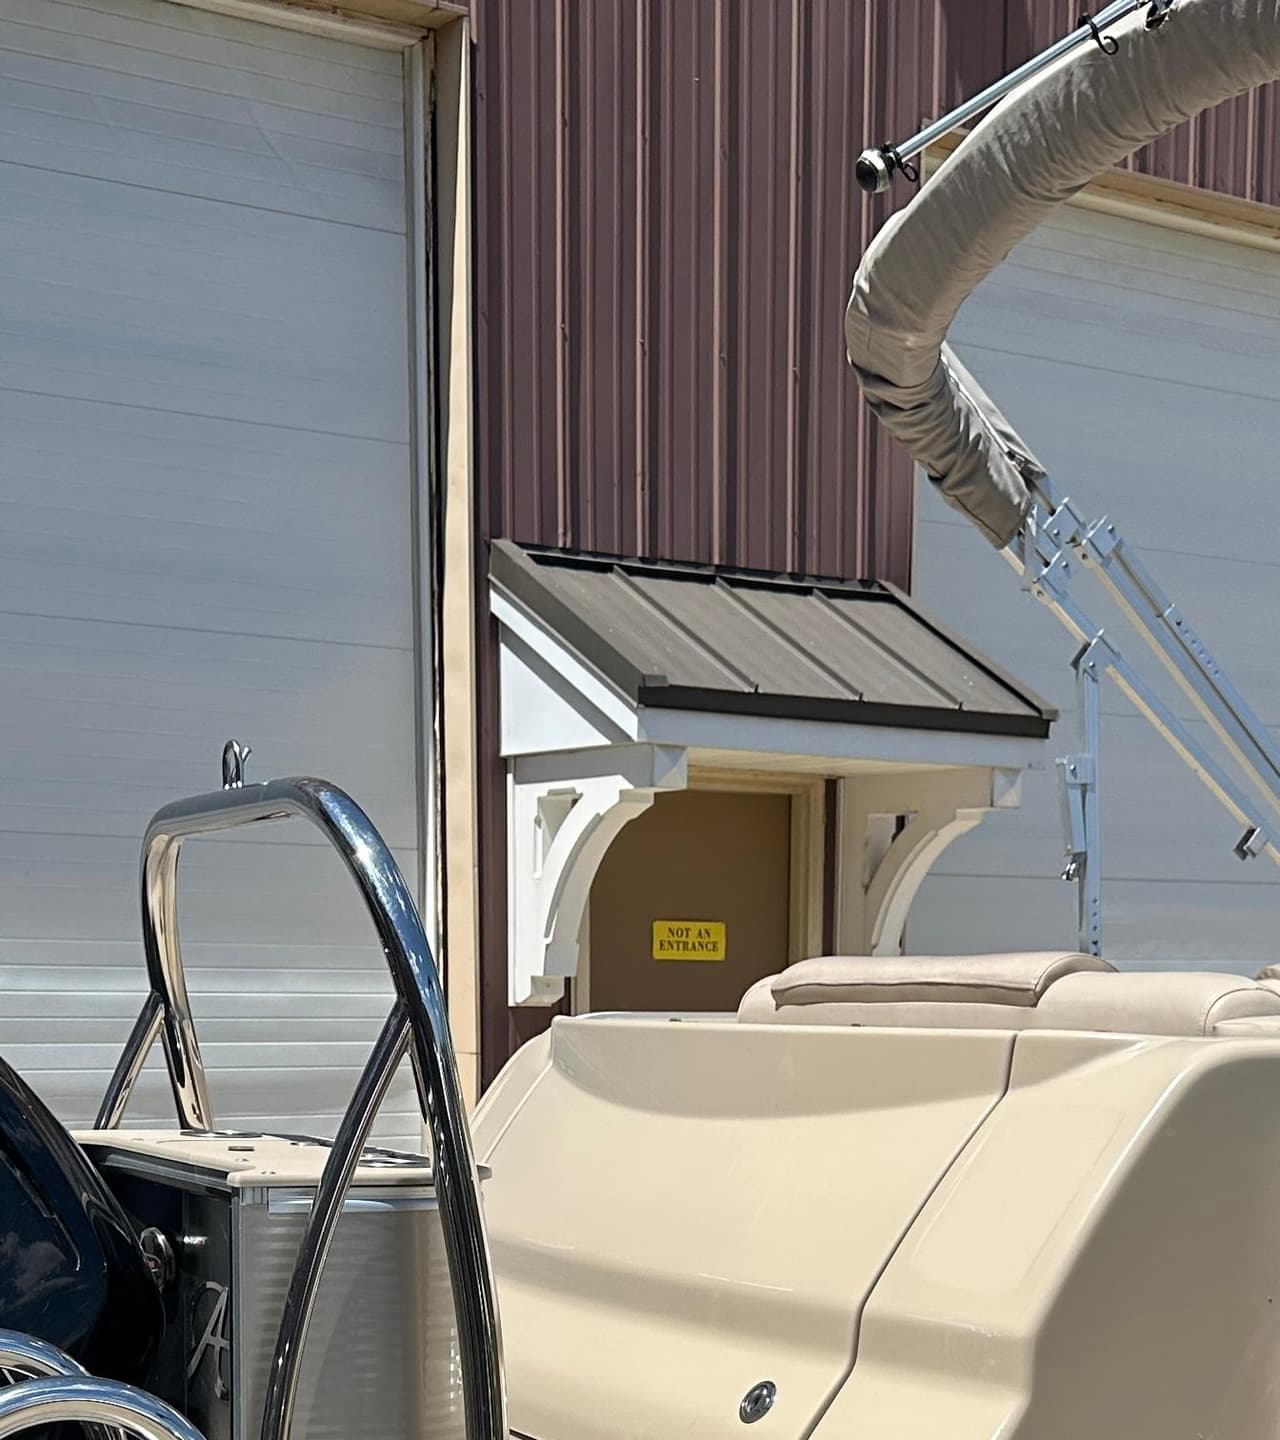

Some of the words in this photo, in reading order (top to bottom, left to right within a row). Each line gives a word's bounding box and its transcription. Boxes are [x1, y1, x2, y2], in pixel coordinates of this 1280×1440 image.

[667, 927, 691, 939] NOT
[696, 927, 711, 939] AN
[659, 939, 719, 952] ENTRANCE
